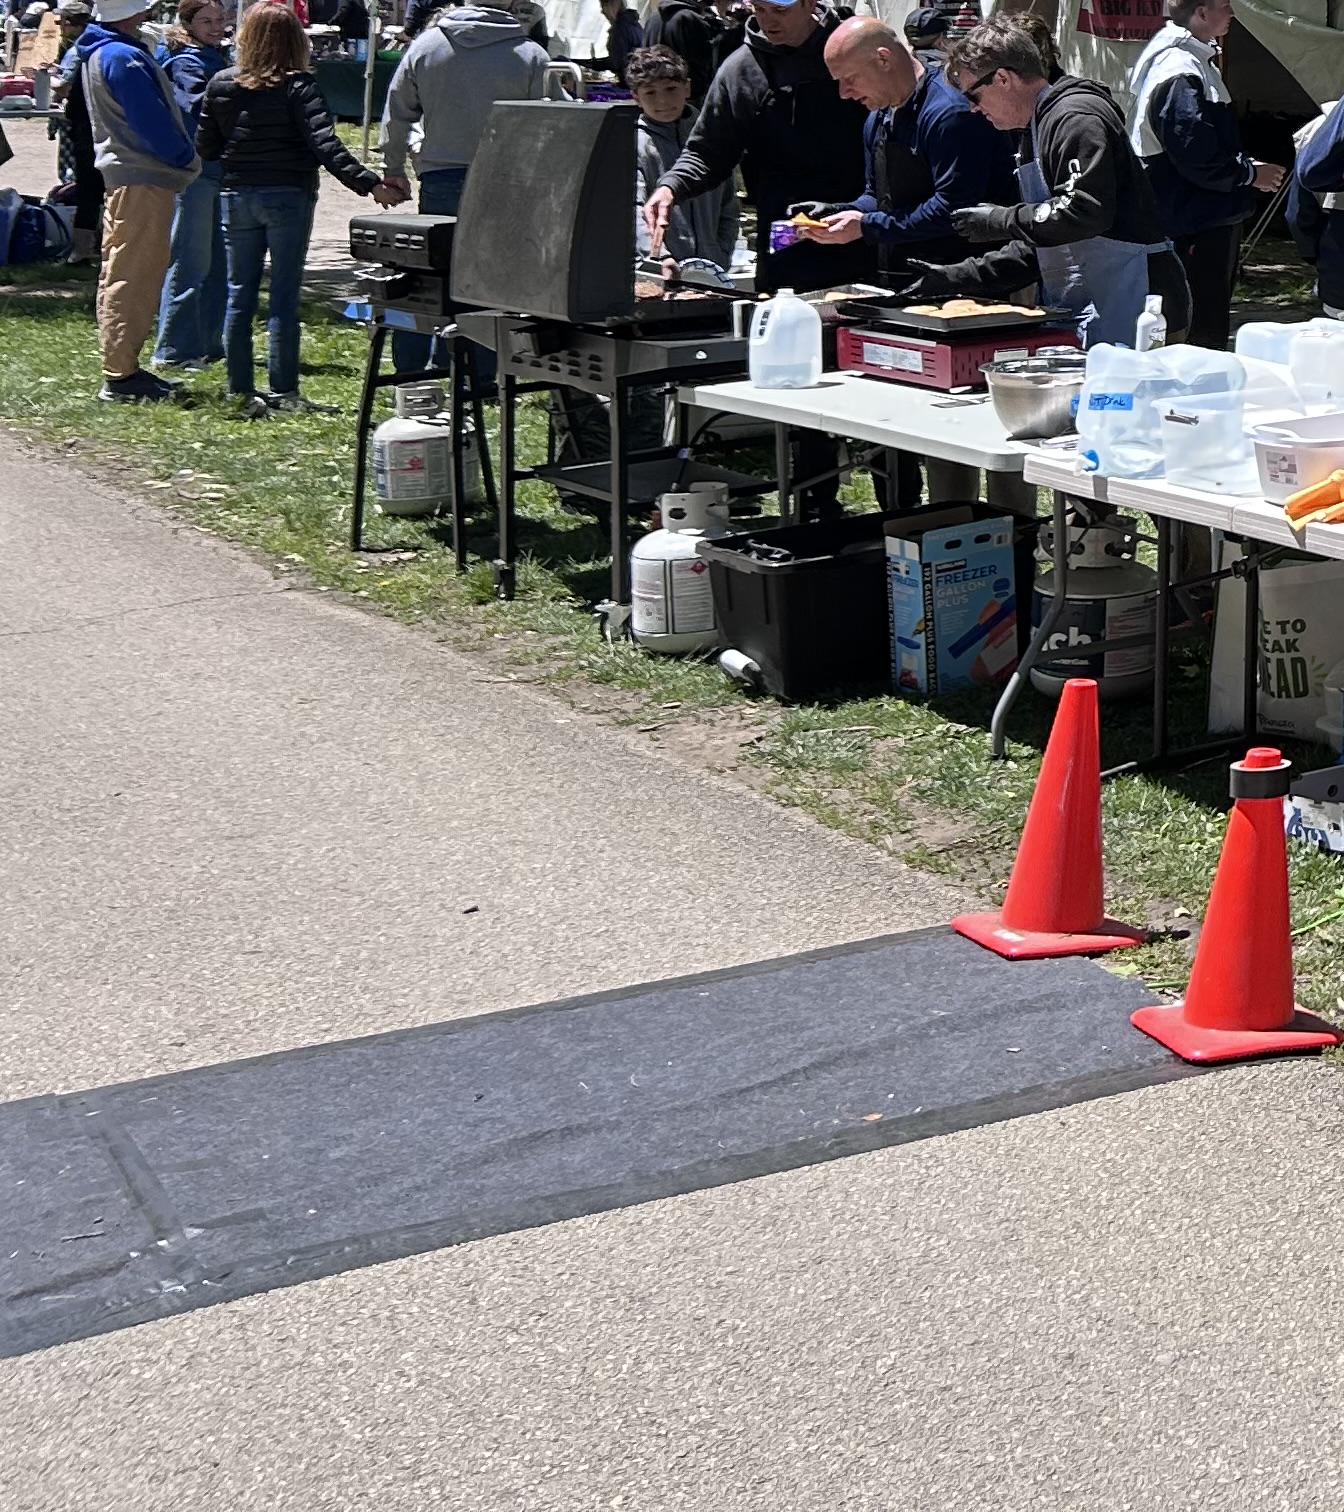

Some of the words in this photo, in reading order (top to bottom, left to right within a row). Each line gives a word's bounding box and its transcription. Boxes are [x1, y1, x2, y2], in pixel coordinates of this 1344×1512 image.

[1100, 0, 1132, 16] BIG
[936, 564, 998, 588] FREEZER
[936, 580, 987, 599] GALLON
[924, 584, 933, 619] GALLON
[937, 594, 970, 609] PLUS
[926, 621, 935, 643] PLUS
[1276, 618, 1307, 635] TO
[927, 645, 936, 670] FOOD
